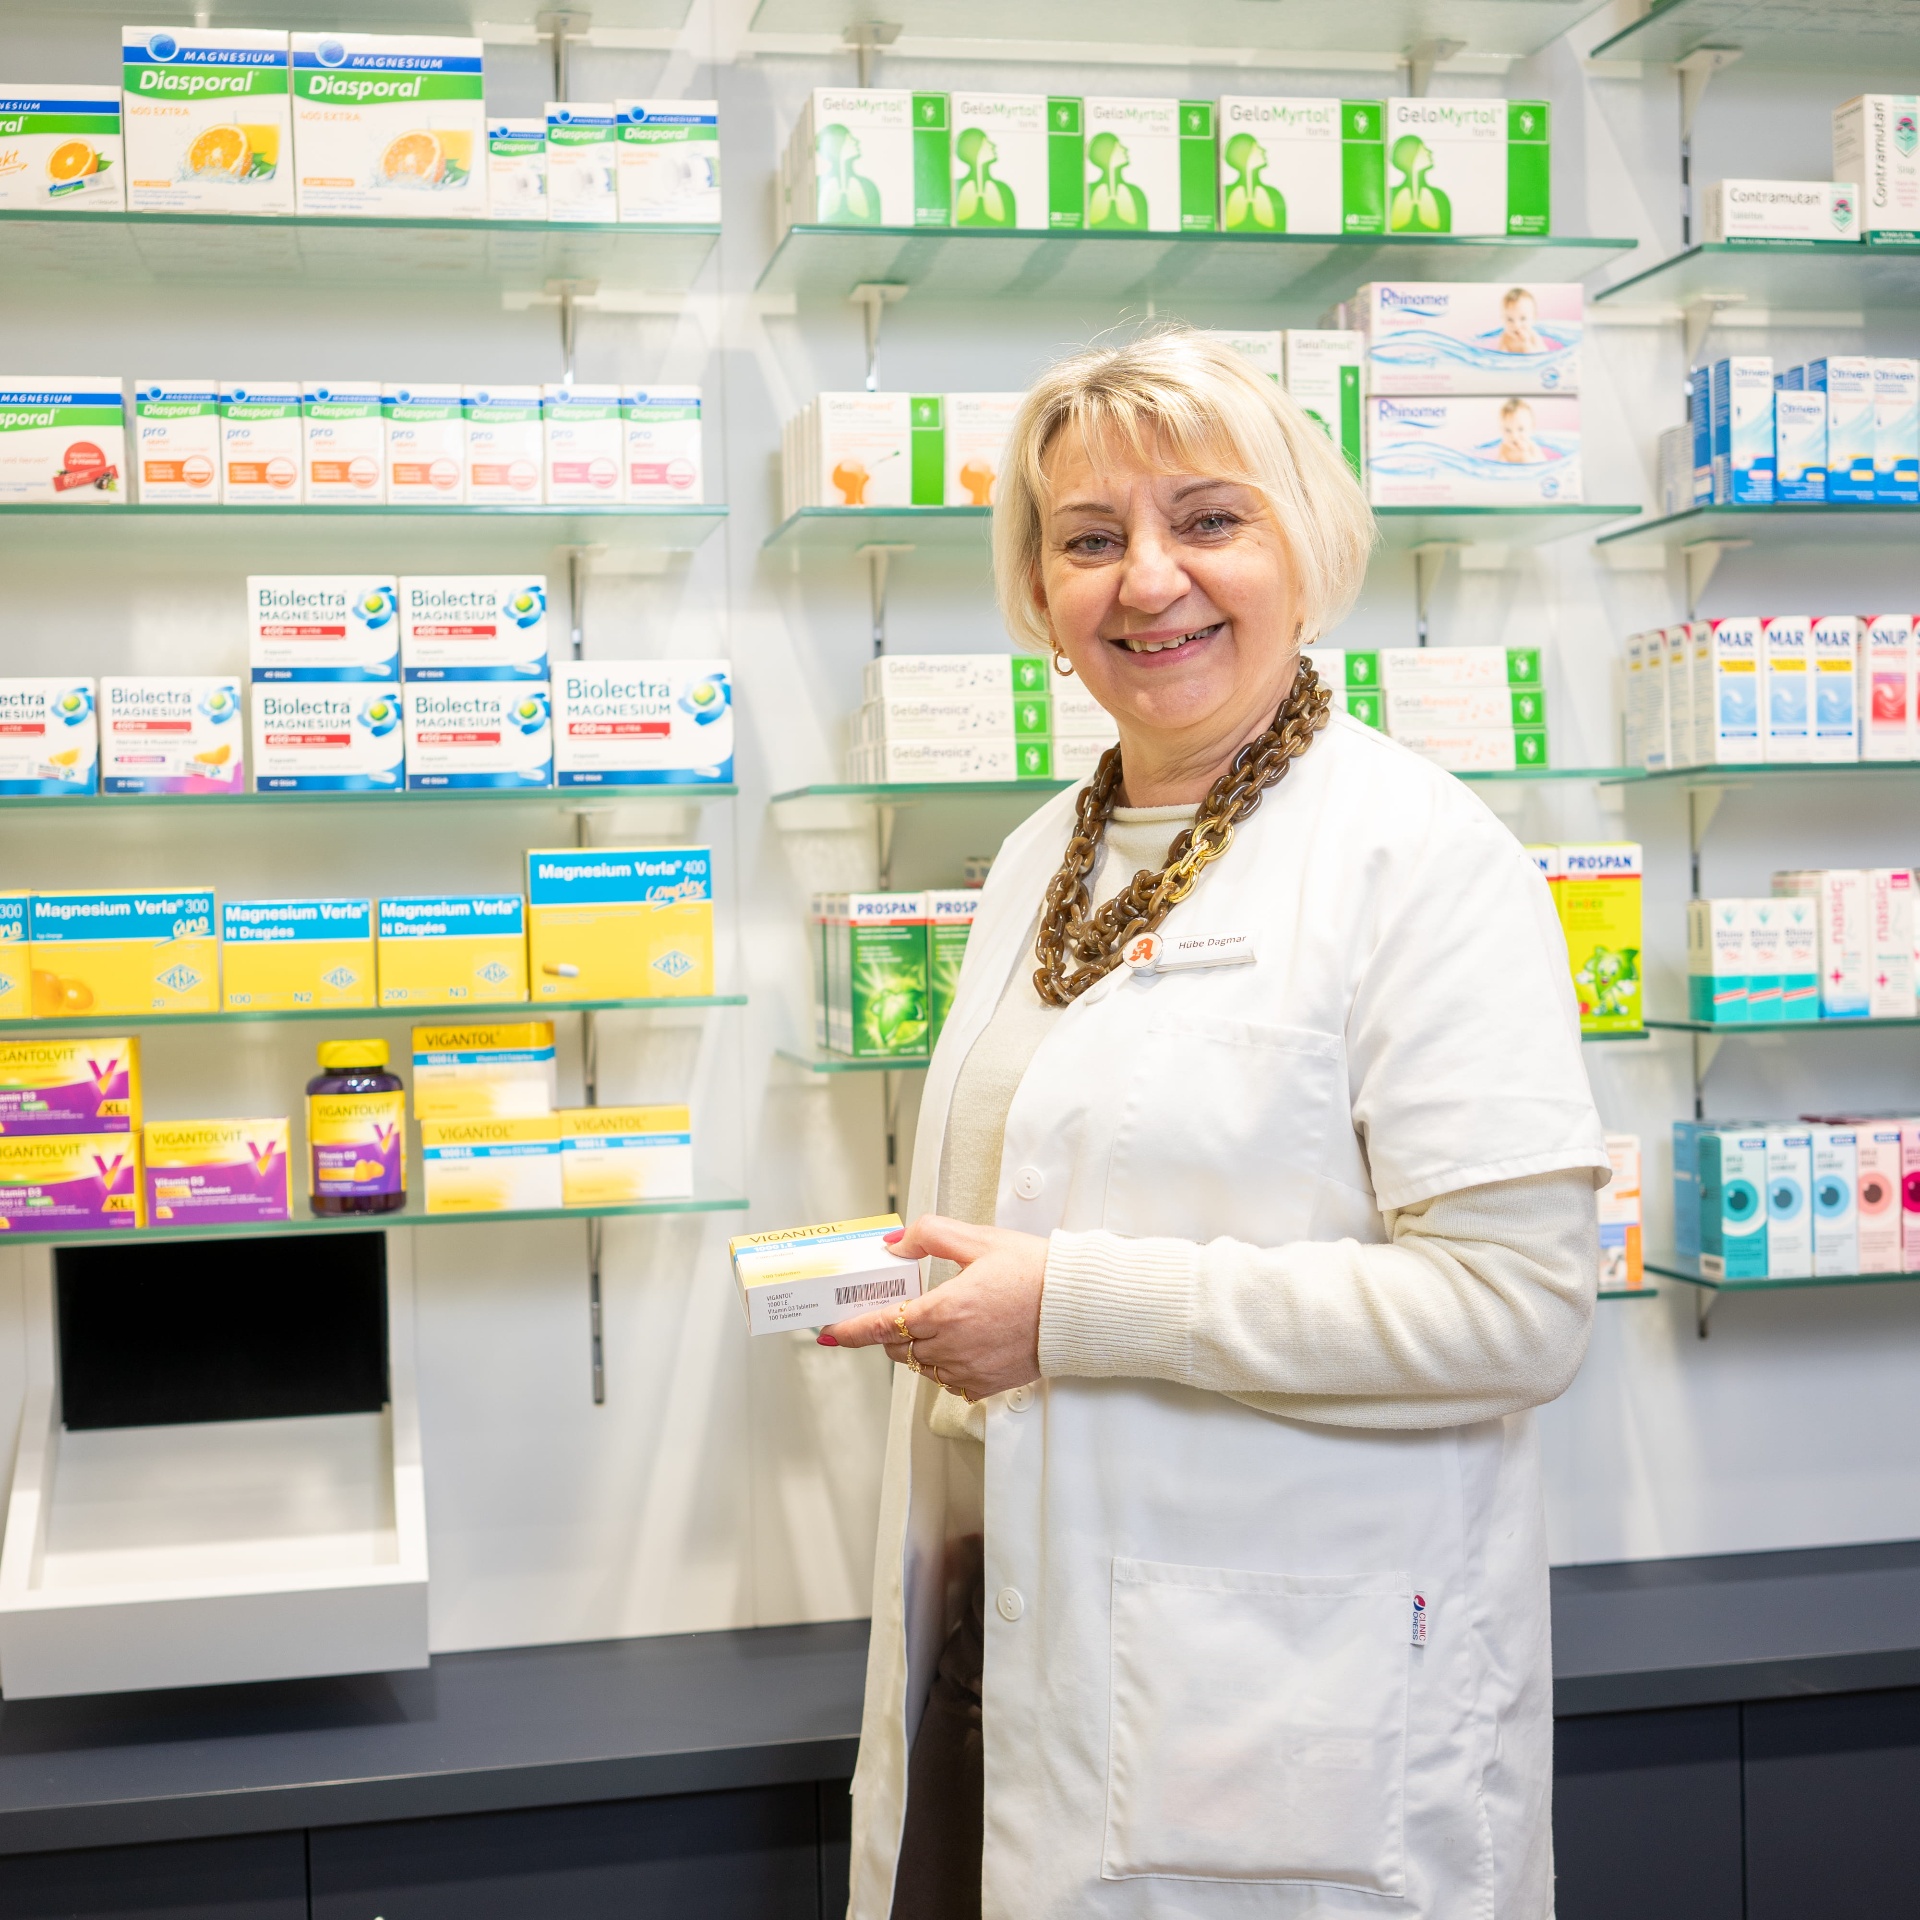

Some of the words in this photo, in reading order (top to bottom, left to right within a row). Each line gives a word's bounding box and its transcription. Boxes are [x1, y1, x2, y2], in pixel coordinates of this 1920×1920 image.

[183, 51, 275, 64] MAGNESIUM
[353, 57, 443, 70] MAGNESIUM
[139, 70, 253, 95] Diasporal
[308, 75, 421, 101] Diasporal
[153, 107, 190, 118] EXTRA
[324, 112, 362, 123] EXTRA
[624, 127, 690, 141] Diasporal
[1873, 100, 1888, 208] Contramutan
[1729, 188, 1821, 206] Contramutan
[1380, 288, 1449, 308] Rhinomer
[1, 393, 72, 403] MAGNESIUM
[143, 403, 201, 417] Diasporal
[227, 405, 286, 419] Diasporal
[310, 403, 368, 417] Diasporal
[392, 406, 448, 420] Diasporal
[471, 408, 527, 421] Diasporal
[1379, 400, 1447, 420] Rhinomer
[143, 426, 167, 440] pro
[227, 428, 250, 441] pro
[310, 426, 333, 440] pro
[392, 429, 414, 441] pro
[471, 430, 493, 442] pro
[259, 589, 346, 607] Biolectra
[412, 590, 496, 608] Biolectra
[259, 611, 347, 621] MAGNESIUM
[412, 610, 497, 621] MAGNESIUM
[1718, 632, 1753, 647] MAR
[1769, 630, 1804, 646] MAR
[1816, 630, 1850, 646] MAR
[1872, 630, 1907, 645] SNUP
[567, 678, 670, 698] Biolectra
[111, 687, 191, 705] Biolectra
[112, 707, 192, 718] MAGNESIUM
[264, 697, 350, 715] Biolectra
[416, 696, 500, 714] Biolectra
[567, 704, 671, 717] MAGNESIUM
[264, 719, 351, 729] MAGNESIUM
[416, 717, 501, 728] MAGNESIUM
[1568, 856, 1632, 870] PROSPAN
[538, 863, 631, 882] Magnesium
[683, 860, 706, 875] 400
[35, 901, 130, 921] Magnesium
[185, 898, 209, 914] 300
[225, 905, 317, 925] Magnesium
[381, 903, 467, 921] Magnesium
[857, 902, 918, 915] PROSPAN
[226, 927, 235, 938] N
[239, 925, 294, 941] Dragées
[381, 924, 392, 935] N
[395, 921, 446, 936] Dragées
[1178, 940, 1205, 950] Hübe
[1207, 935, 1247, 947] Dagmar
[229, 994, 251, 1005] 100
[294, 992, 312, 1003] N2
[384, 989, 408, 1000] 200
[425, 1032, 498, 1047] VIGANTOL
[316, 1103, 391, 1118] VIGANTOLVIT
[574, 1115, 643, 1131] VIGANTOL
[152, 1130, 242, 1146] VIGANTOLVIT
[438, 1124, 511, 1140] VIGANTOL
[750, 1224, 840, 1244] VIGANTOL
[753, 1244, 780, 1253] 1000
[780, 1242, 796, 1251] I.E.
[816, 1234, 846, 1245] Vitamin
[846, 1233, 857, 1241] D3
[766, 1292, 791, 1302] VIGANTOL
[767, 1306, 787, 1315] Vitamin
[796, 1302, 819, 1311] Tabletten
[779, 1312, 802, 1320] Tabletten
[1418, 1612, 1426, 1641] CLINIC
